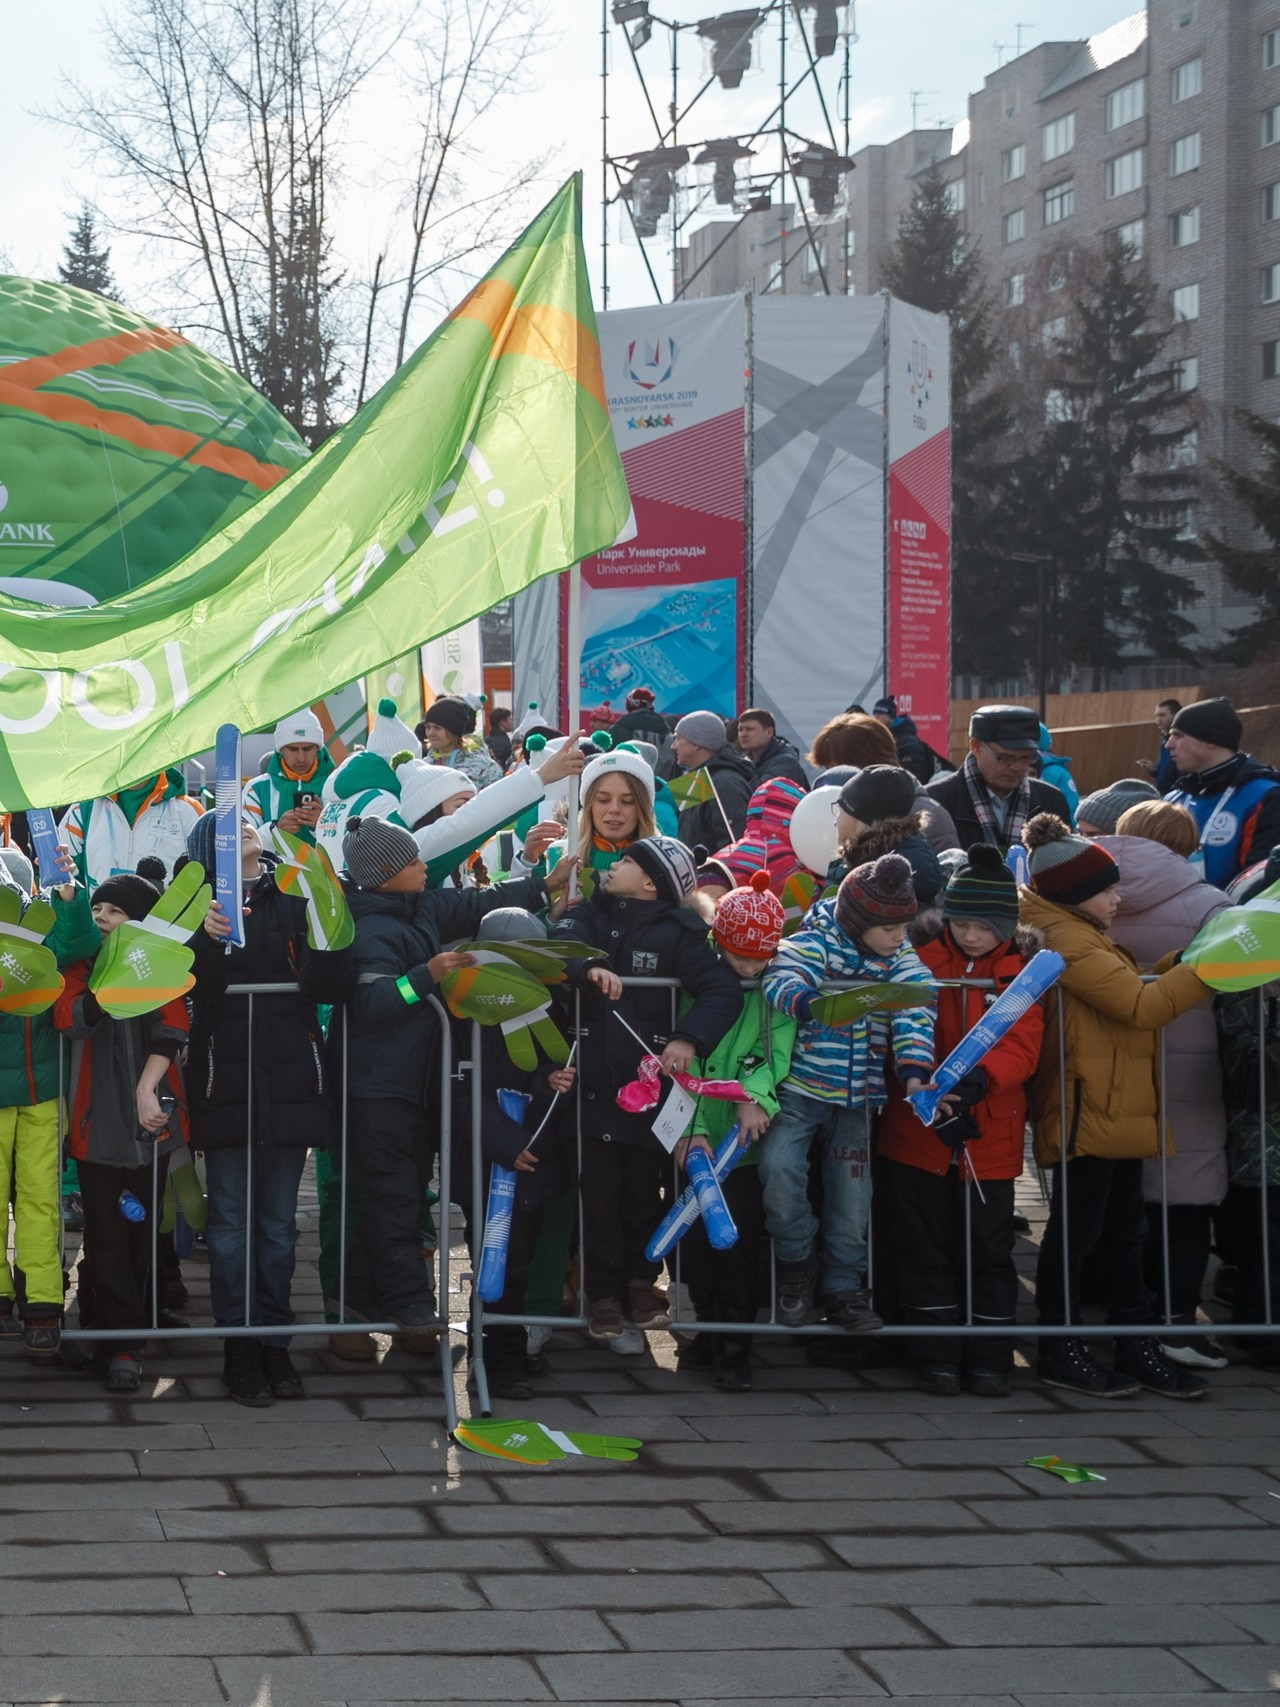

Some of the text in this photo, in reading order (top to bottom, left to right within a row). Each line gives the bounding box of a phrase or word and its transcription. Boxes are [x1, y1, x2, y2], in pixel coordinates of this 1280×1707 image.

[676, 391, 698, 401] 2019
[623, 404, 650, 413] WINTER
[628, 546, 706, 560] Универсиады
[597, 561, 682, 576] Universiade Park
